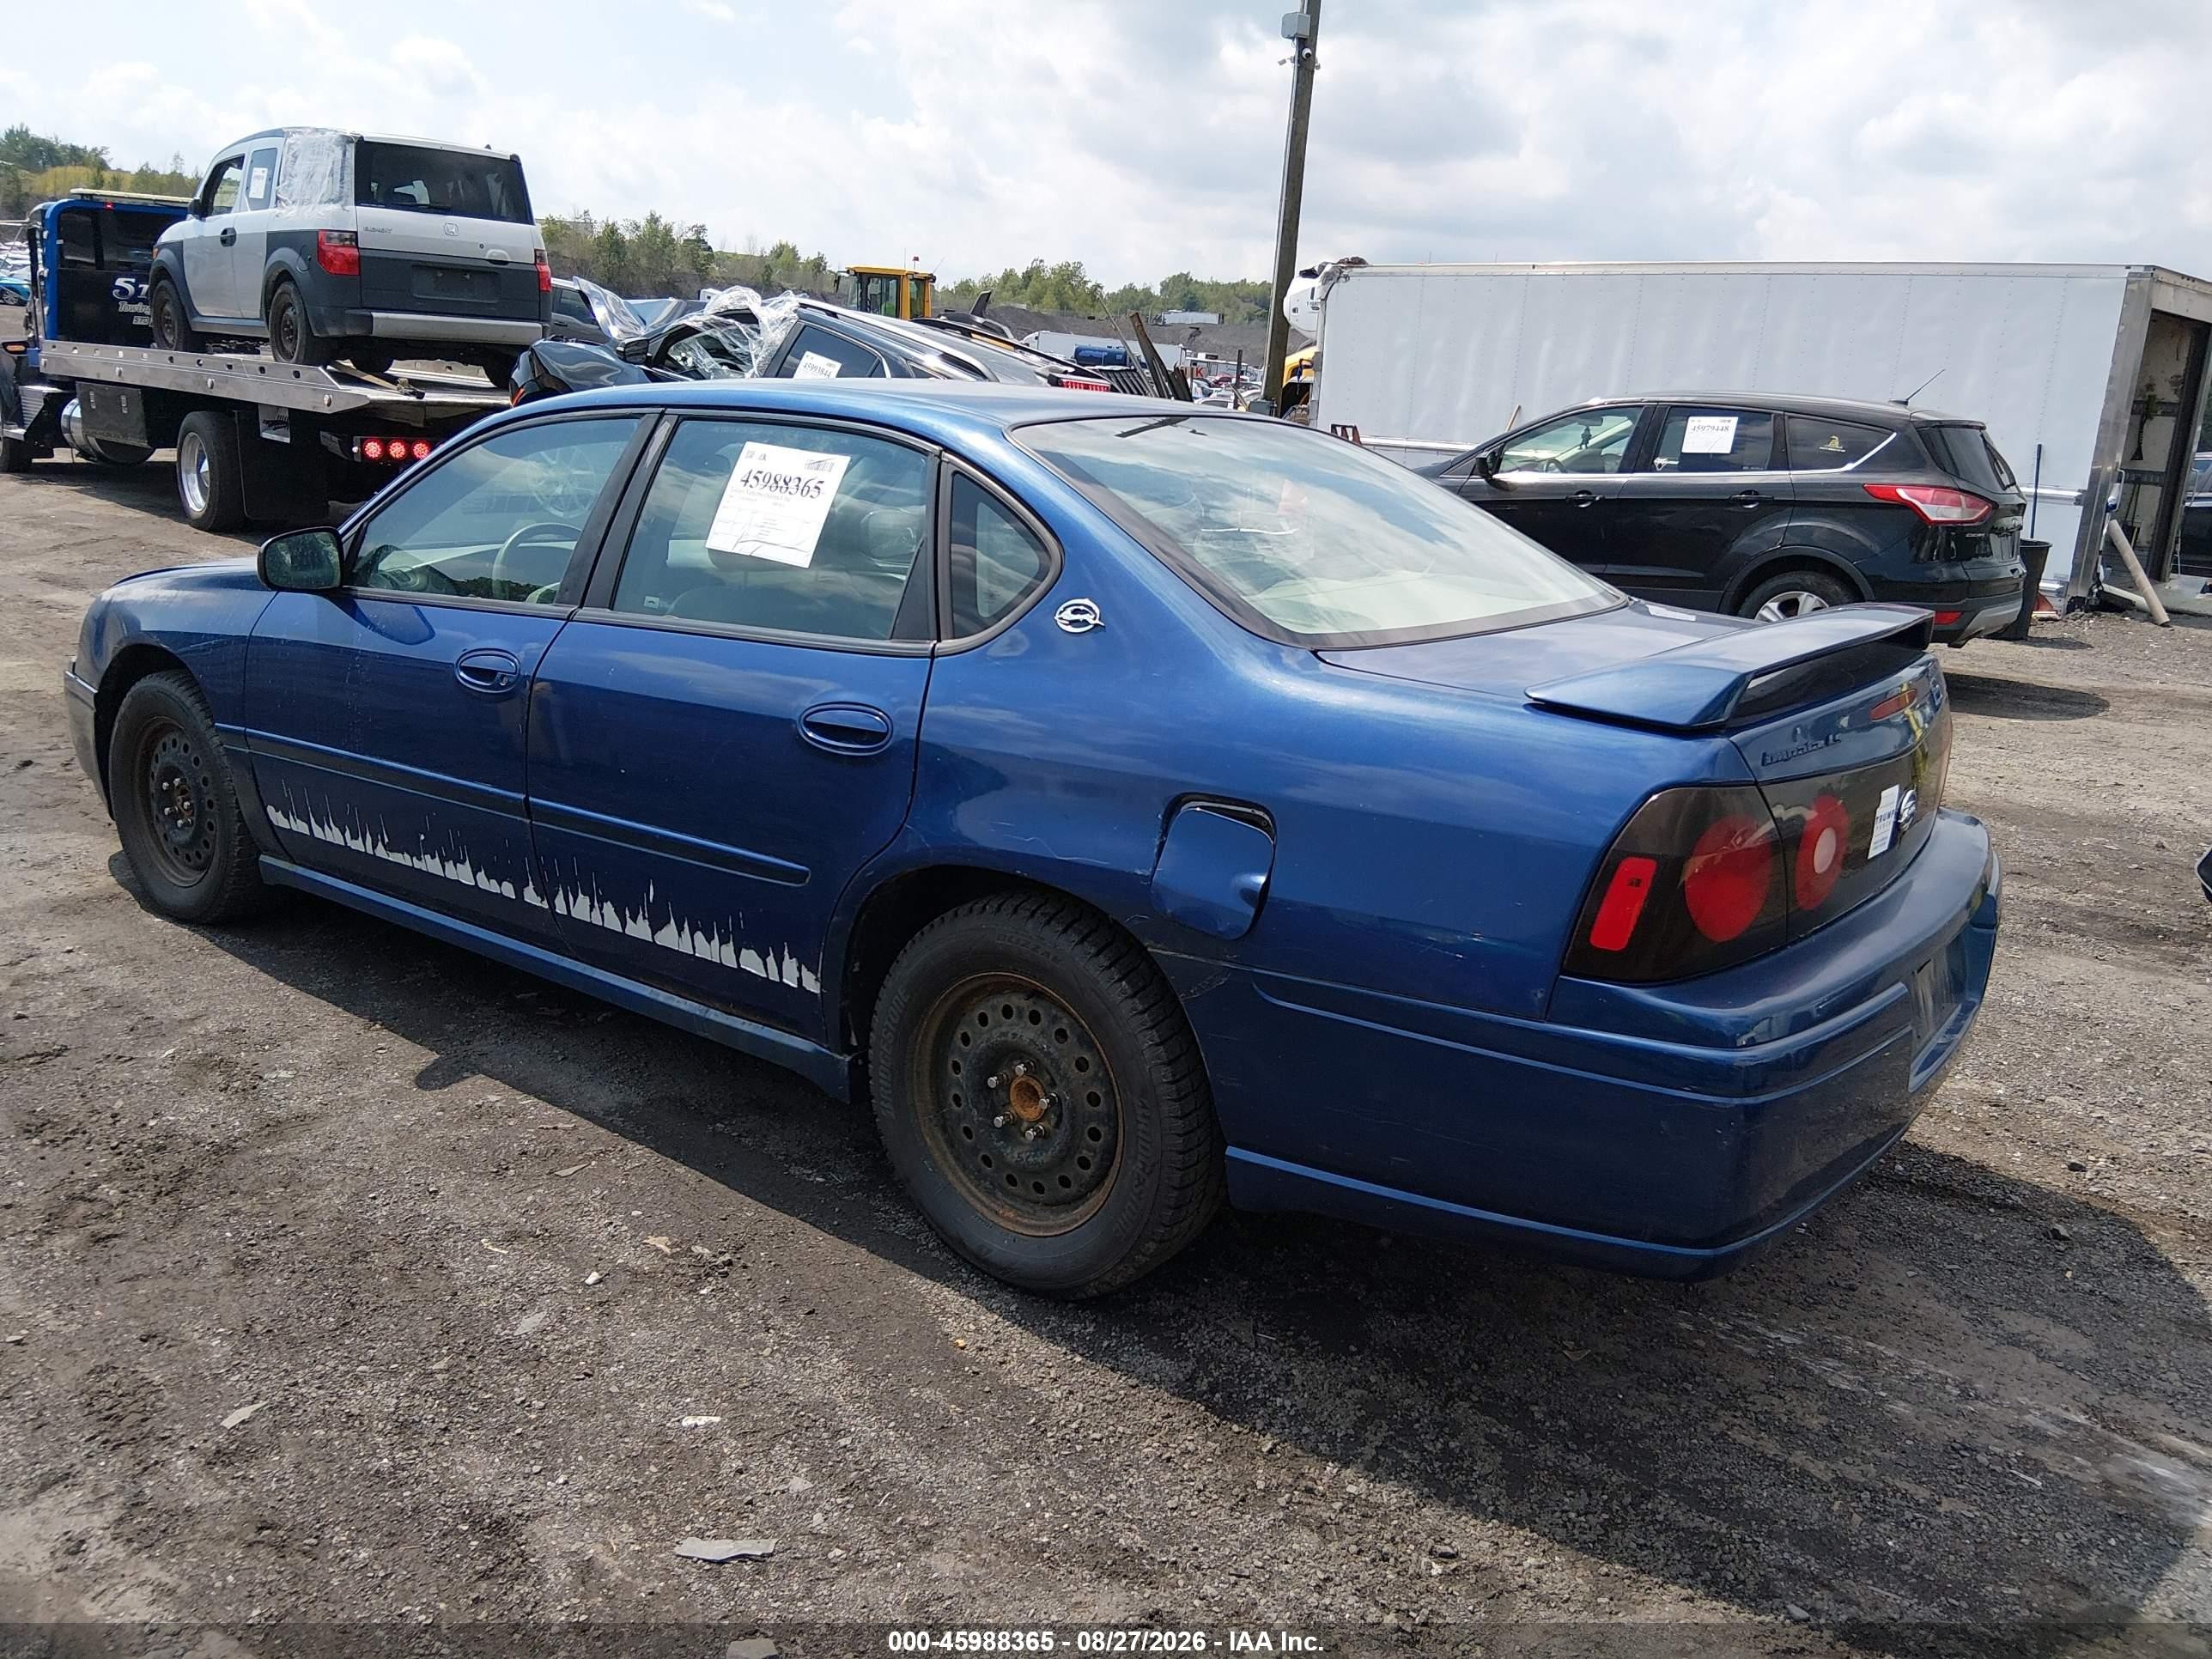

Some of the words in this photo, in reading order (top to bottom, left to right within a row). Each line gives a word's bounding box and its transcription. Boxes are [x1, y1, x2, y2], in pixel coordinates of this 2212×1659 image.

[739, 468, 825, 500] 45988365
[1875, 809, 1895, 824] TRUMP
[878, 985, 910, 1118] BRIDGESTONE
